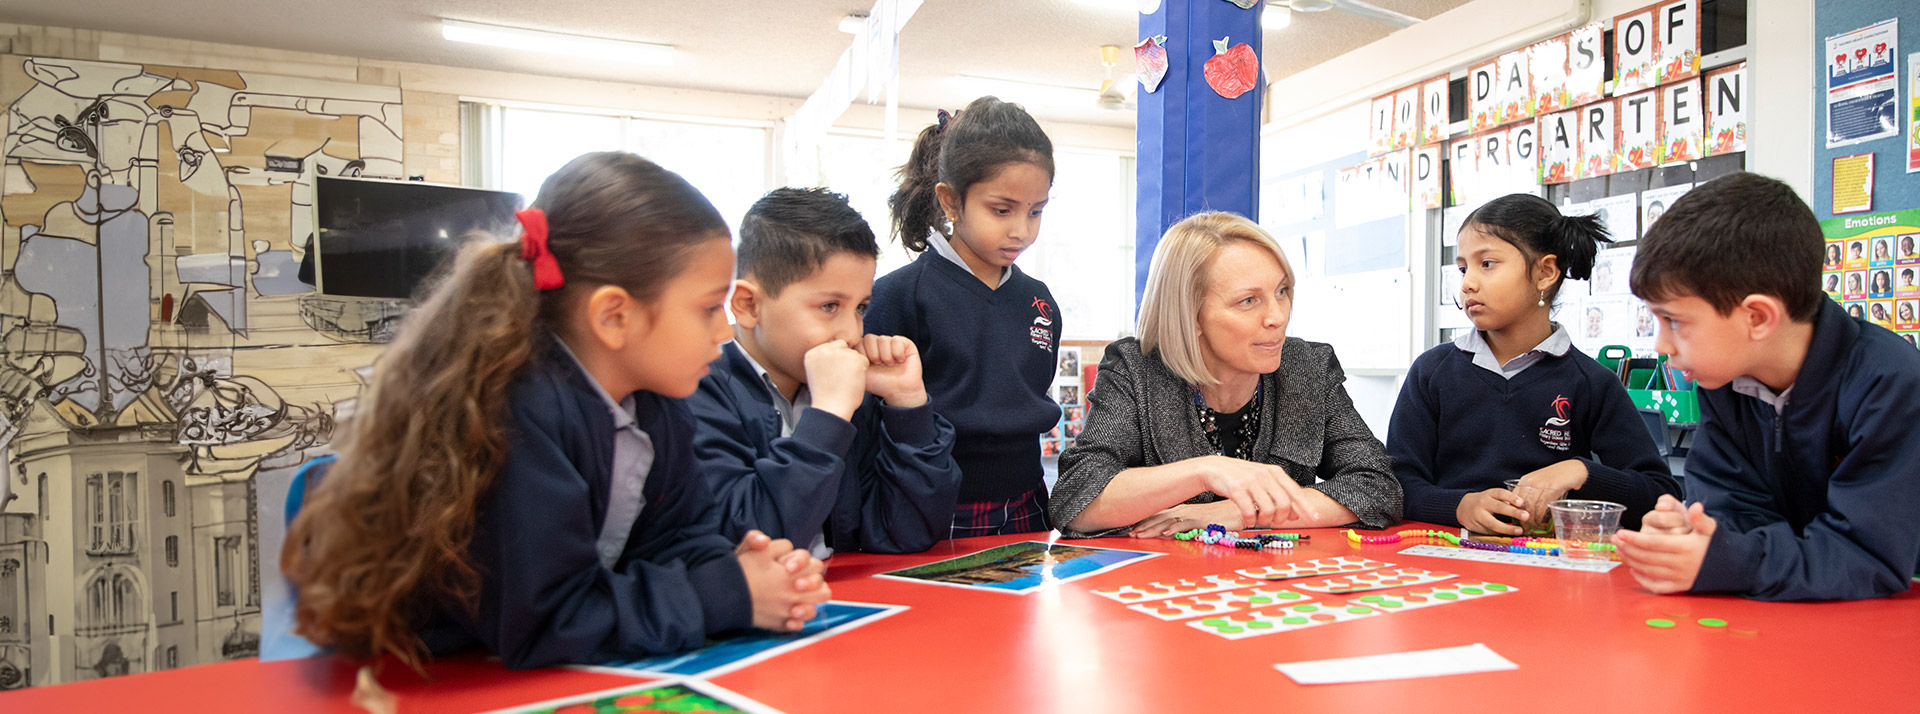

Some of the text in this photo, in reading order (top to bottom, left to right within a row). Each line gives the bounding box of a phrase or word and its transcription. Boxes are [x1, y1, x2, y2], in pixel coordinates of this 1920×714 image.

[1379, 3, 1687, 131] 100 DAS OF
[1844, 215, 1897, 229] Emotions
